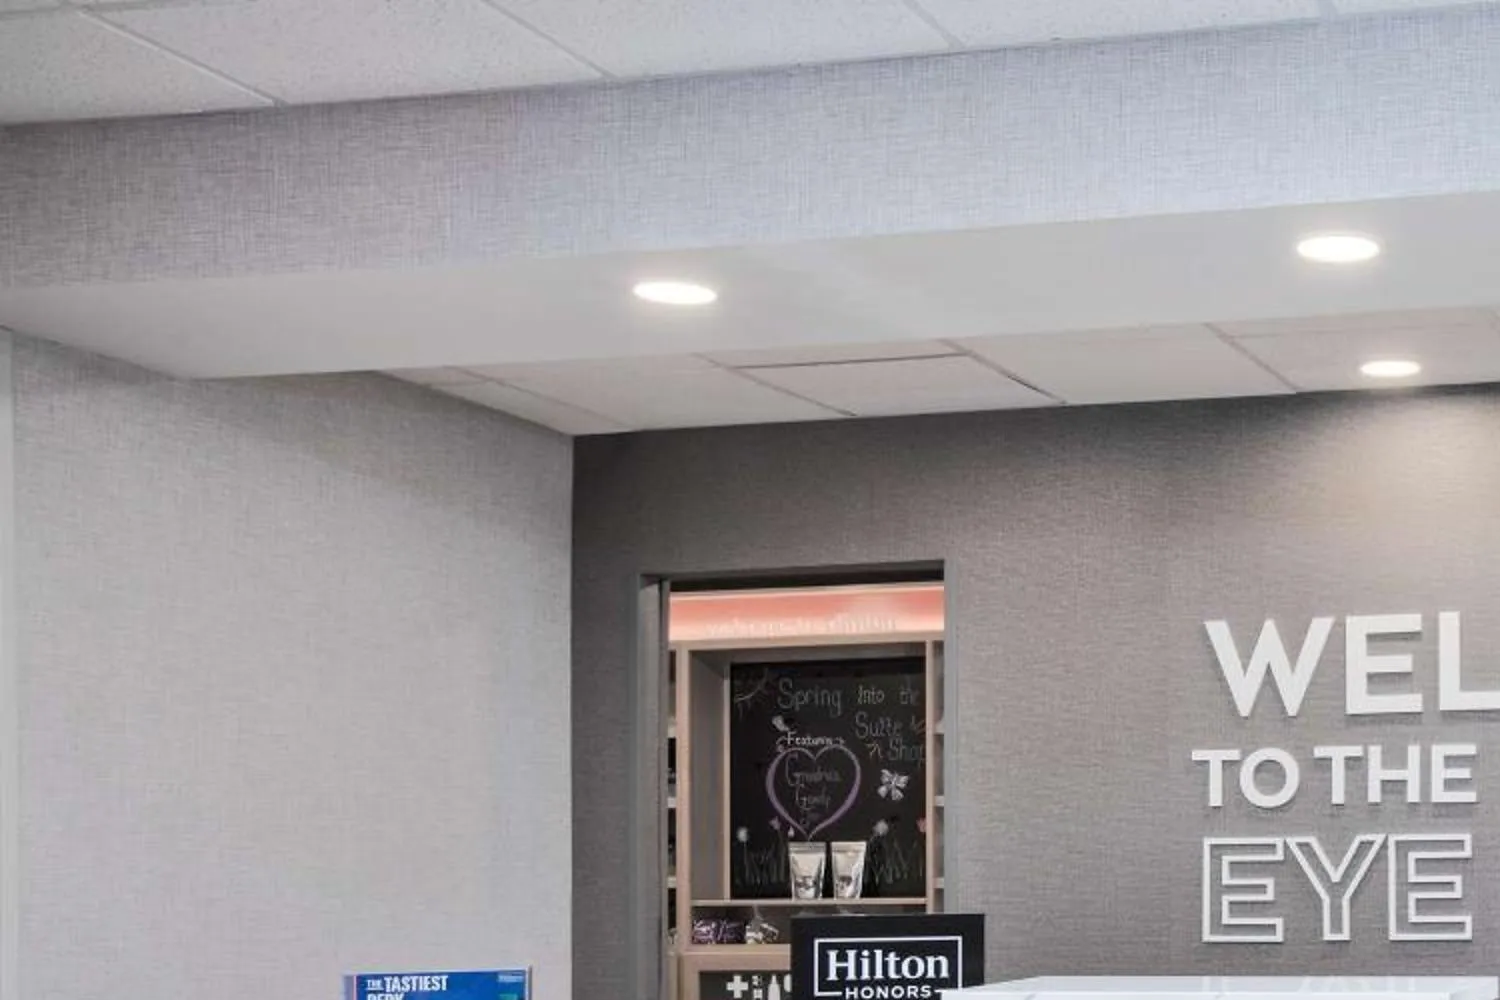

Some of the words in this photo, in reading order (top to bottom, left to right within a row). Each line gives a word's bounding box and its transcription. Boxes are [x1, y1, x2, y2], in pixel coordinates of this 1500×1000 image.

[778, 678, 843, 718] Spring
[1192, 747, 1300, 808] TO
[1314, 743, 1478, 805] THE
[1202, 833, 1474, 943] EYE
[826, 949, 949, 981] Hilton
[366, 979, 383, 990] THE
[384, 975, 449, 992] TASTIEST
[845, 985, 932, 1000] HONORS
